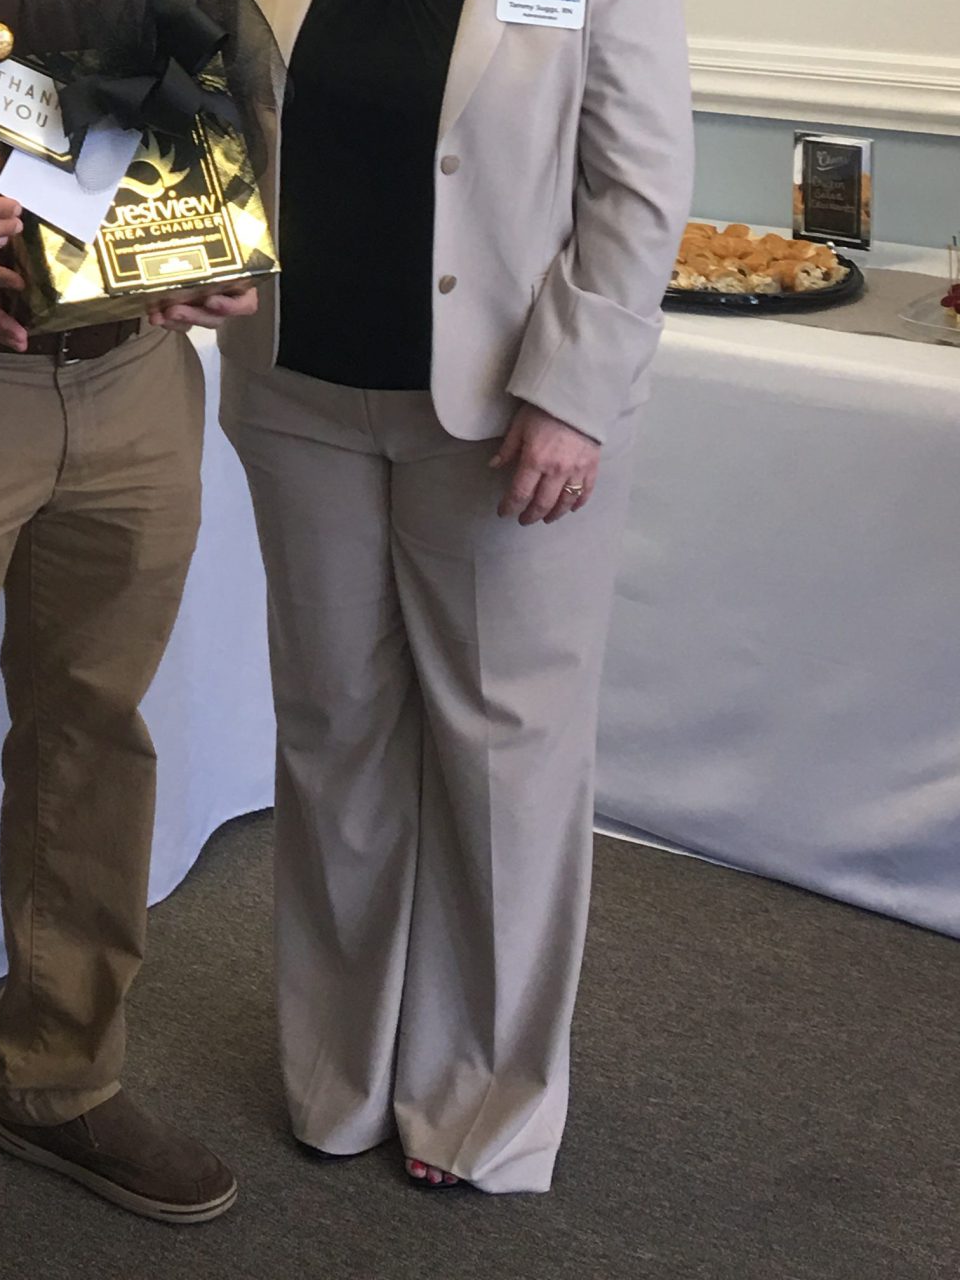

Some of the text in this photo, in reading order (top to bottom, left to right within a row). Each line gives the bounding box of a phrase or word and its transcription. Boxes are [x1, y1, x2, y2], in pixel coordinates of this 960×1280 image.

[3, 96, 49, 128] YOU
[104, 215, 223, 242] AREA CHAMBER
